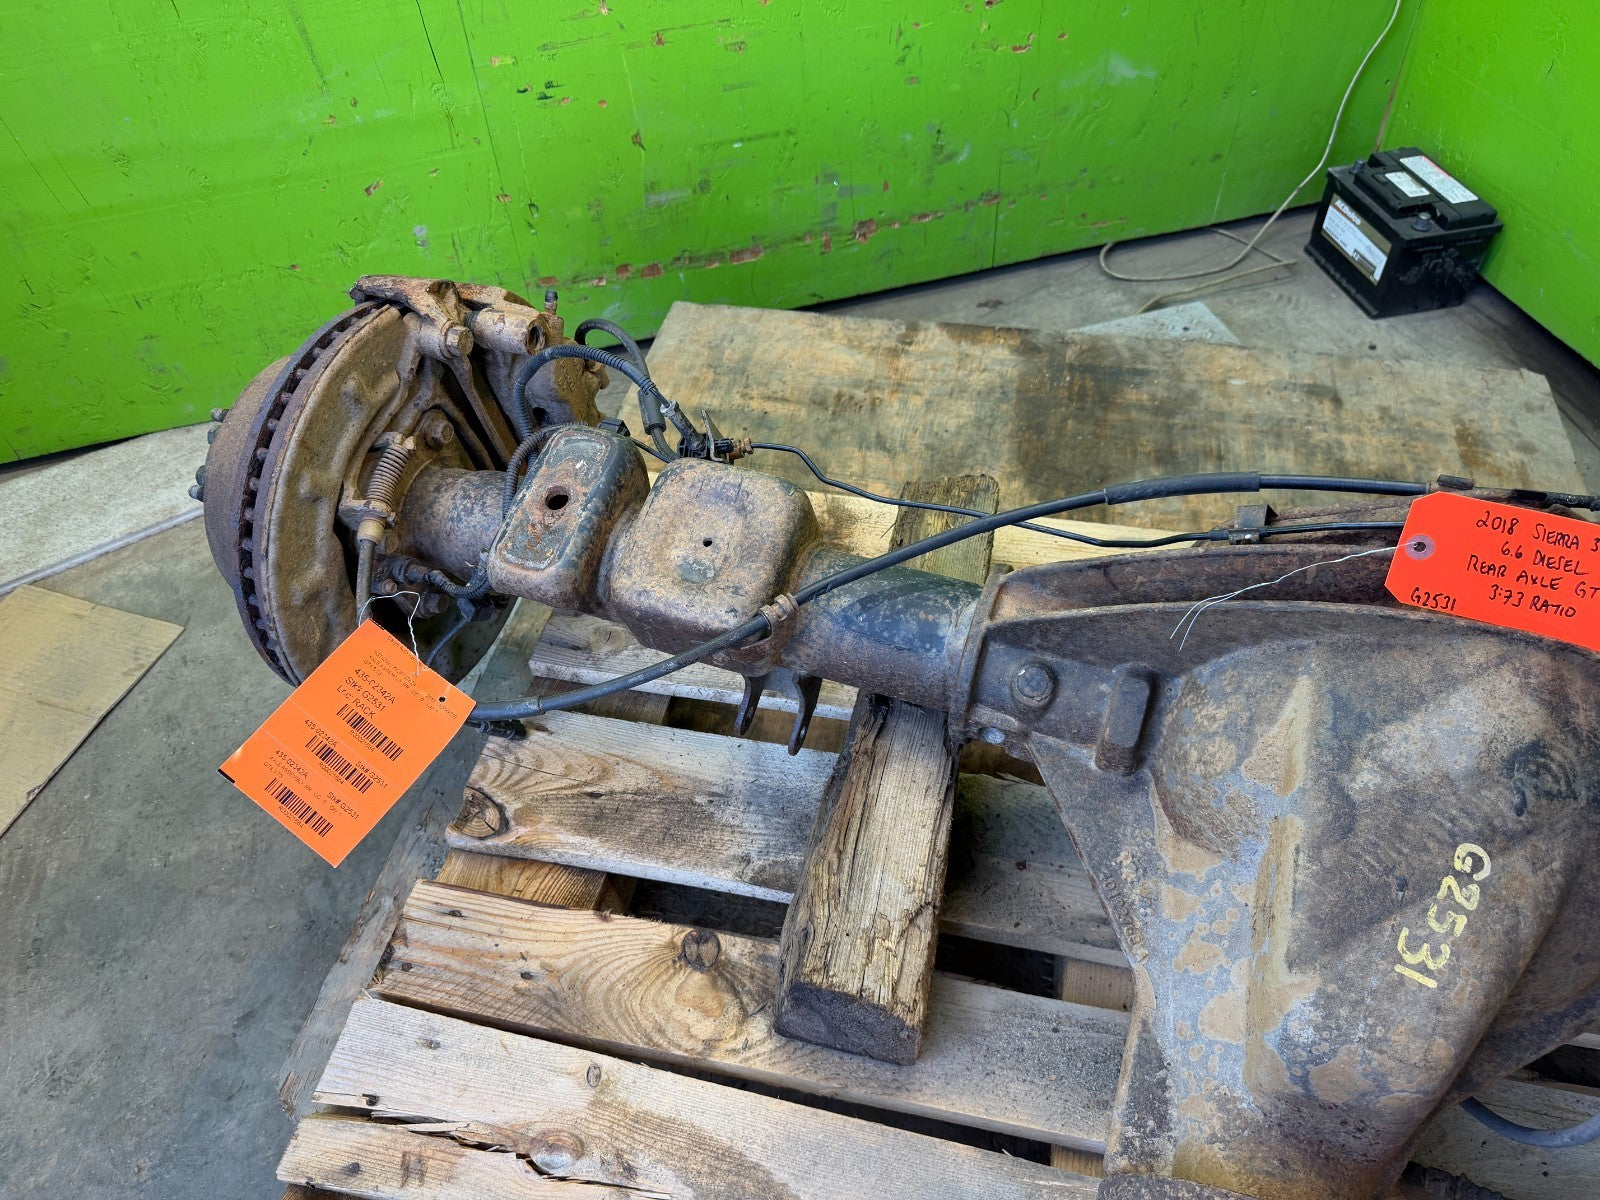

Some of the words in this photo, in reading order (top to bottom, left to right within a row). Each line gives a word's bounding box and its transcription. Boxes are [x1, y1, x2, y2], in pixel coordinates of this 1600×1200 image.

[1476, 511, 1519, 535] 2018
[1532, 523, 1579, 550] SIERRA
[1467, 554, 1507, 577] REAR
[1516, 570, 1563, 590] AXLE
[1501, 541, 1523, 559] 6.6
[1533, 550, 1589, 575] DIESEL
[1411, 587, 1456, 611] G2531
[1489, 584, 1524, 608] 3:73
[1530, 595, 1576, 617] RATIO
[352, 698, 376, 719] RACK
[361, 690, 386, 711] G2531
[354, 761, 369, 774] Stk#
[368, 771, 388, 788] G2531
[326, 791, 341, 804] Stk#
[339, 802, 359, 820] G2531
[1394, 843, 1491, 988] G2531
